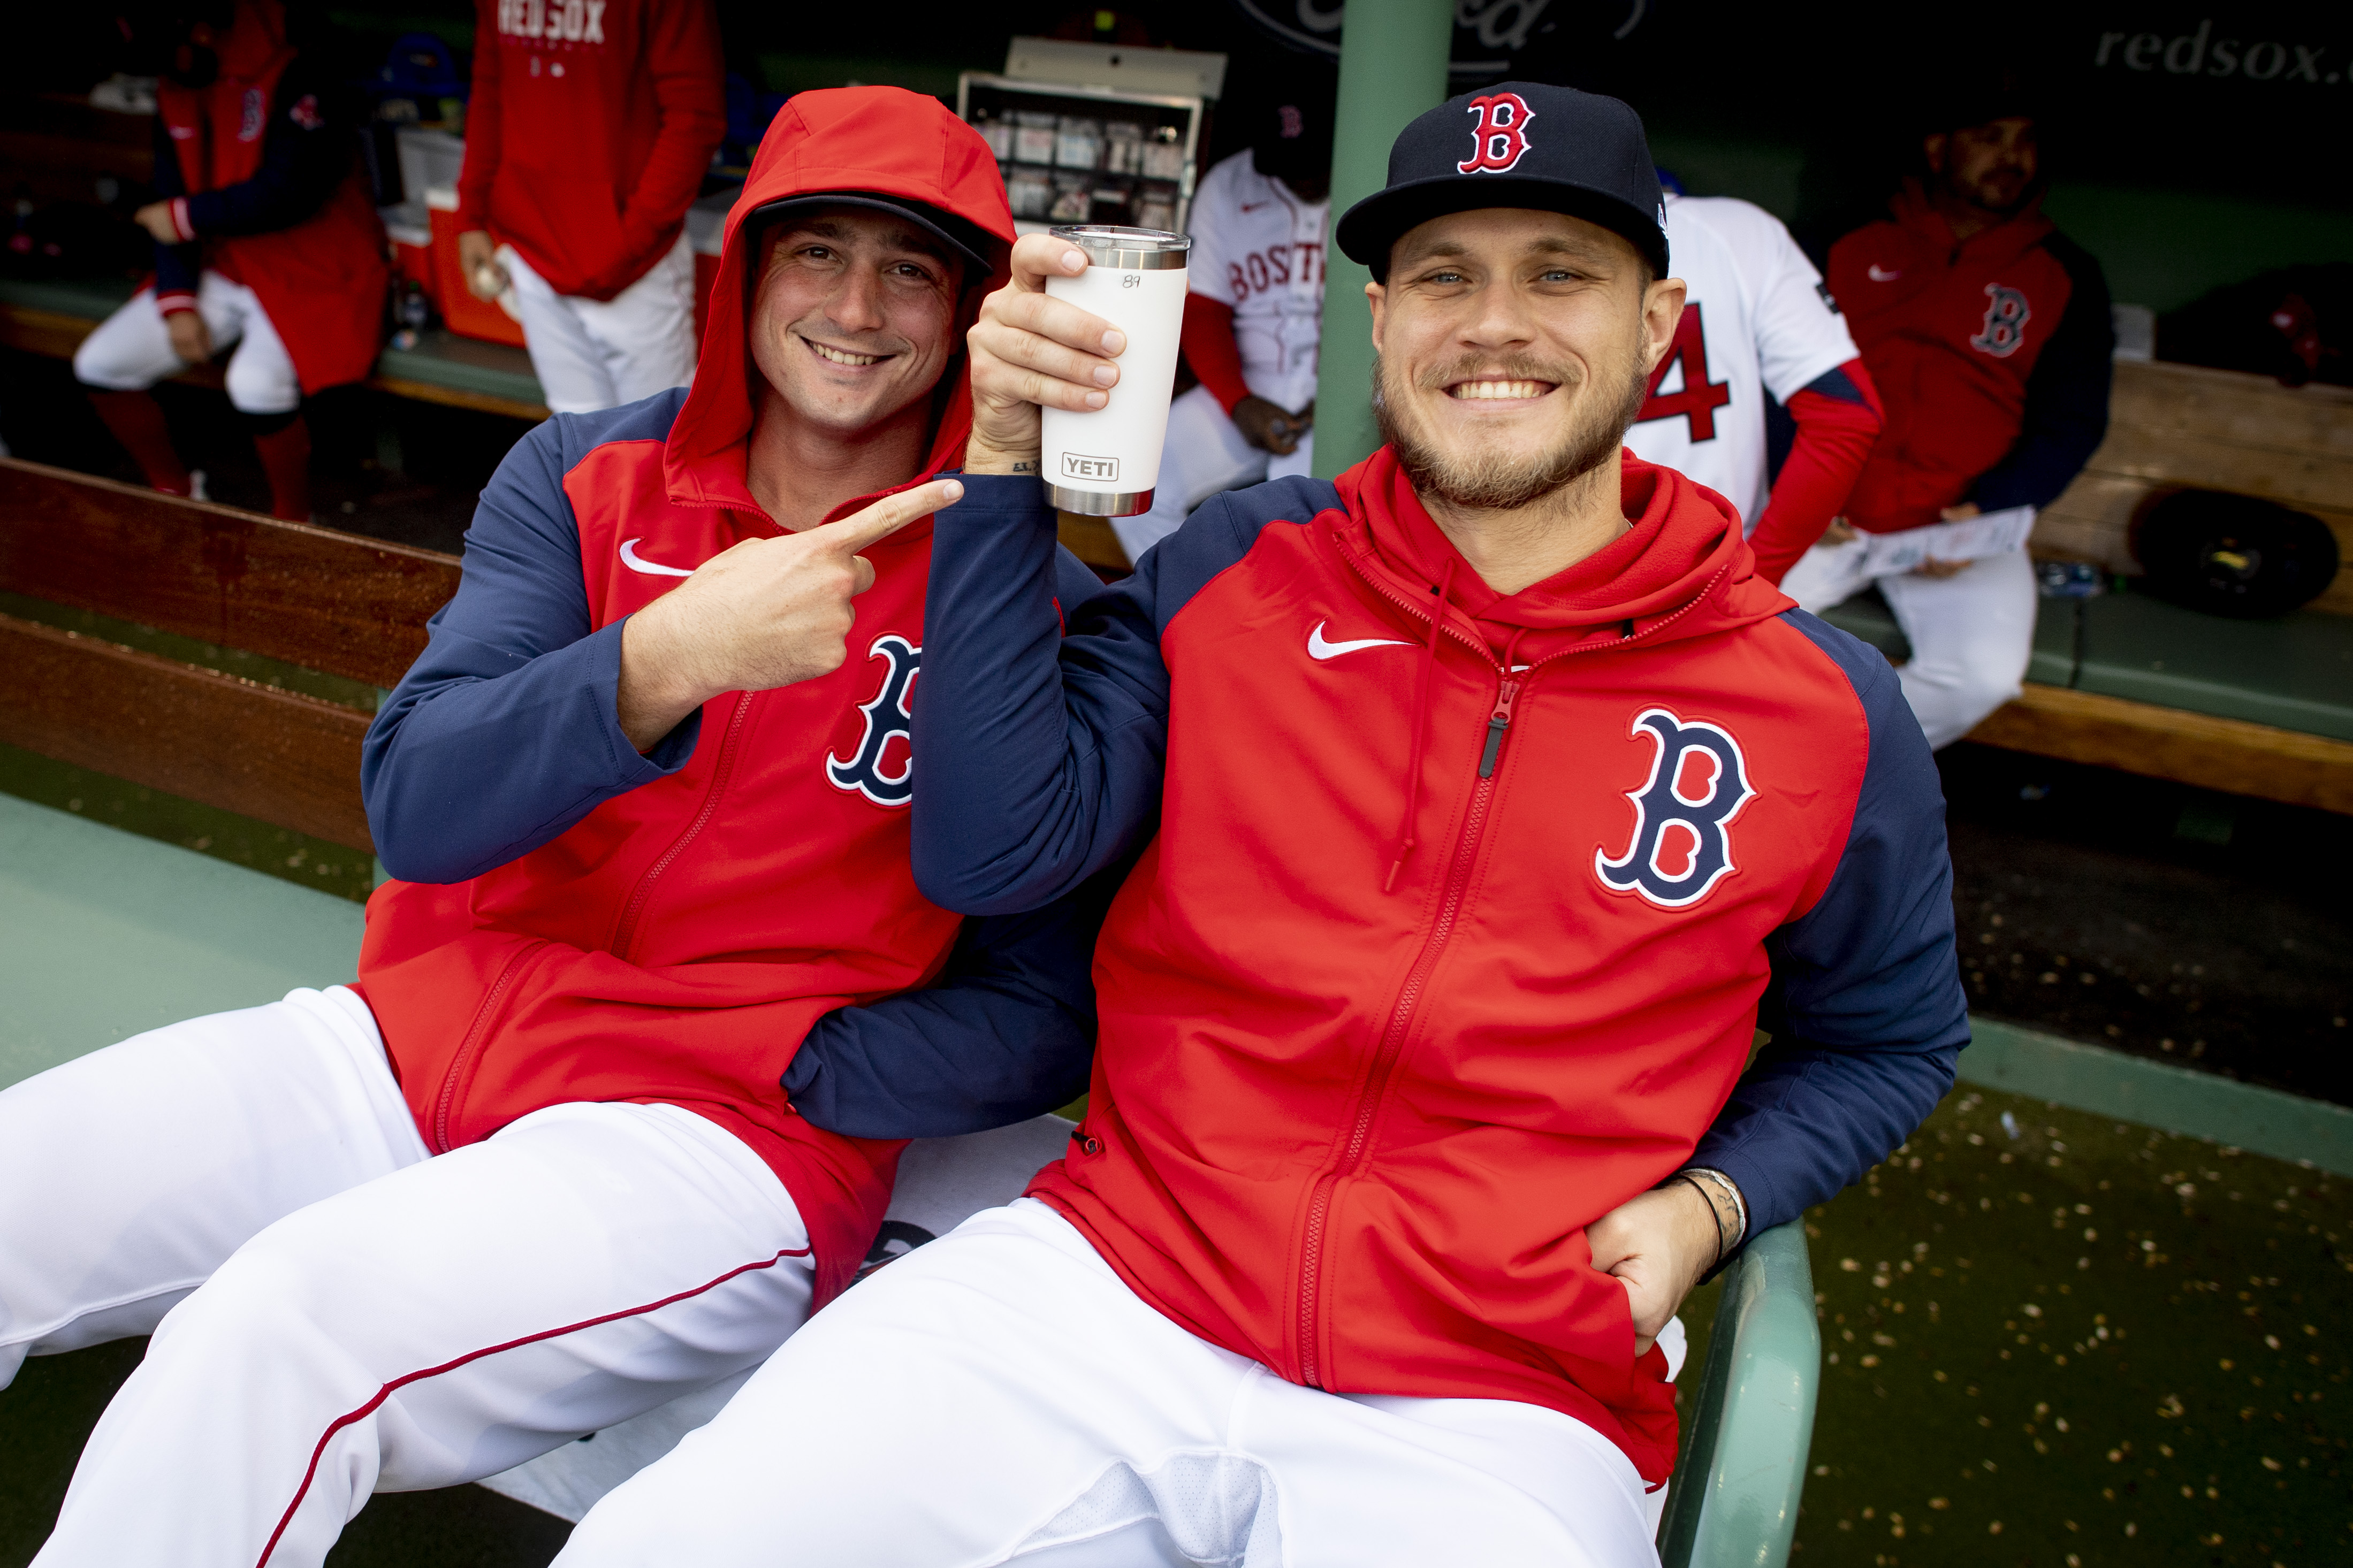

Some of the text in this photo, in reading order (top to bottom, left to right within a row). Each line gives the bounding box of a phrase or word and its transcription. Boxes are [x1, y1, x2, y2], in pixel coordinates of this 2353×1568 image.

[2093, 17, 2353, 86] redsox.
[1457, 91, 1536, 174] B
[1123, 274, 1140, 288] 89
[1229, 242, 1326, 302] BOST
[1969, 282, 2032, 358] B
[1067, 457, 1113, 477] YETI
[827, 634, 922, 806] B
[1595, 708, 1756, 906] B
